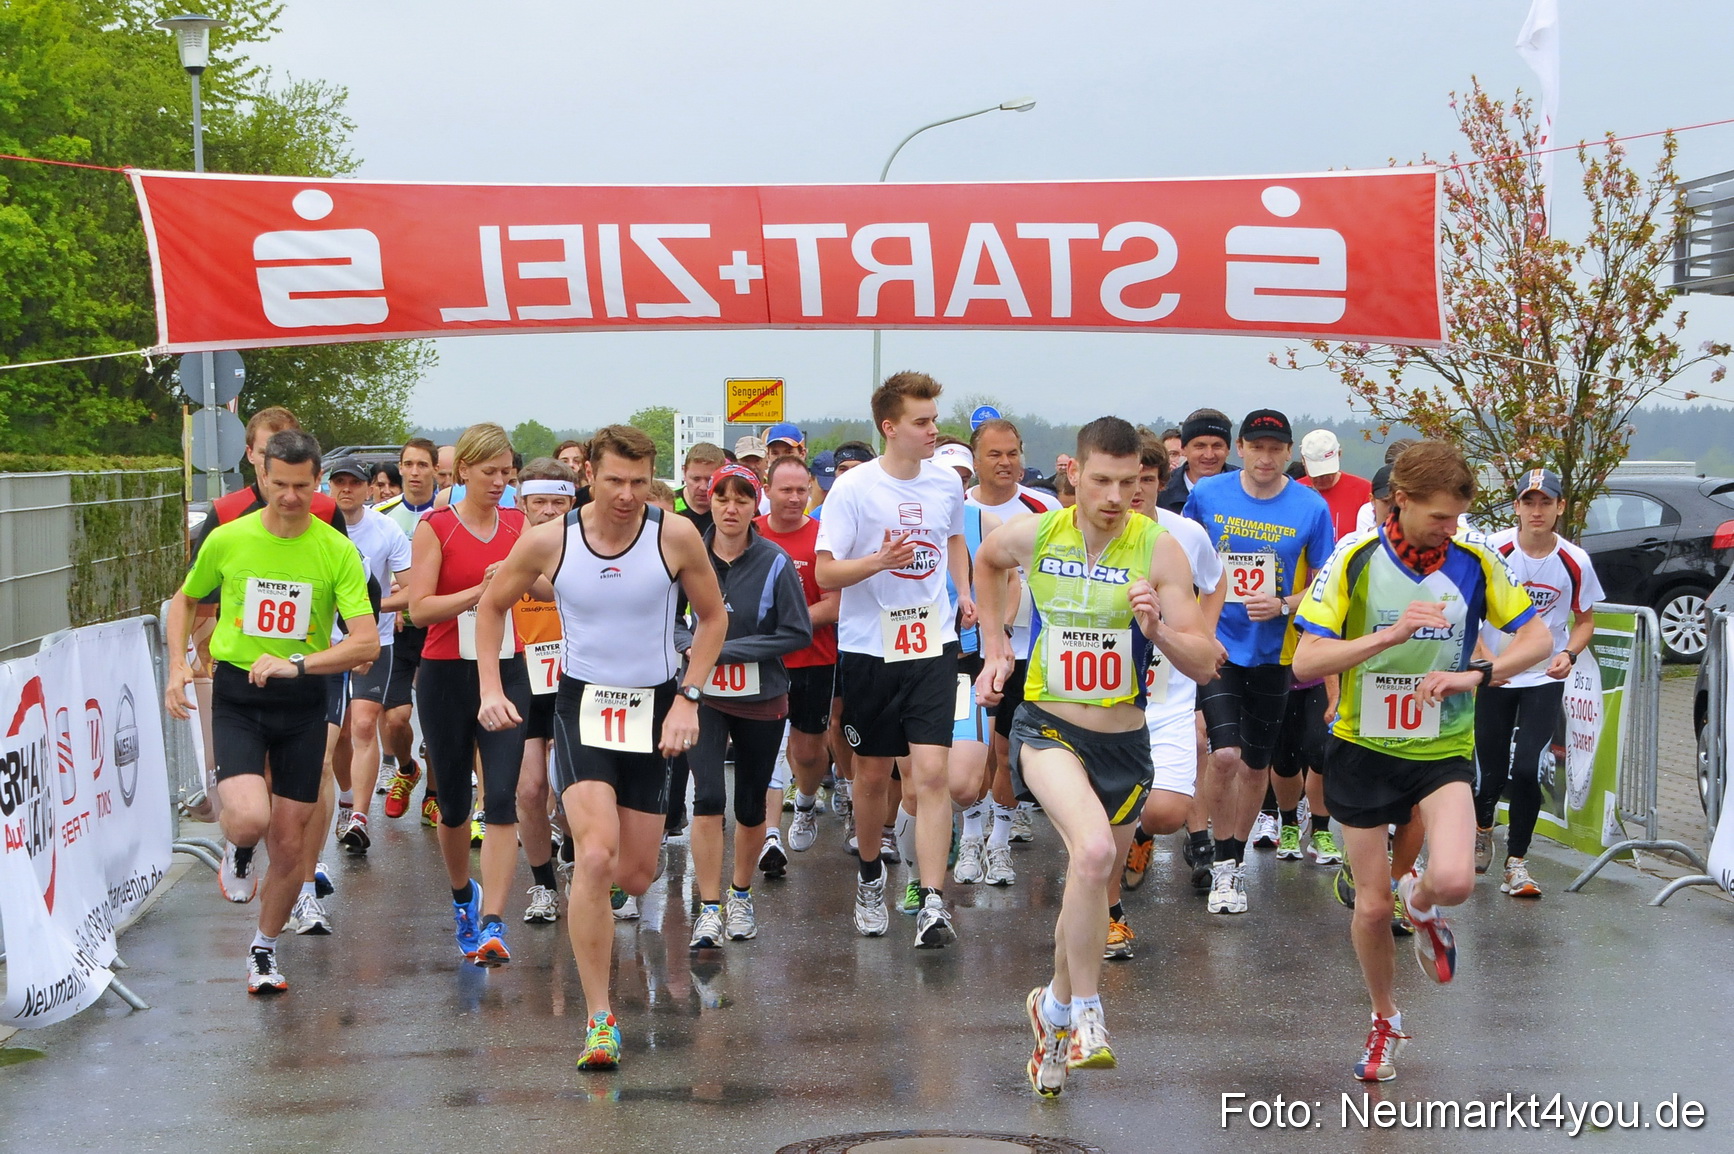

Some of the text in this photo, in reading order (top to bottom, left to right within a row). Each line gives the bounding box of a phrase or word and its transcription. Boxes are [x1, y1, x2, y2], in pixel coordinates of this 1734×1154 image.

[732, 385, 778, 399] Sengenthal
[1213, 514, 1297, 538] 10. NEUMARKTER
[1223, 525, 1282, 544] STADTLAUF
[1228, 554, 1254, 562] MEYER
[1038, 556, 1130, 585] BOCK
[257, 580, 288, 591] MEYER
[1233, 568, 1265, 597] 32
[257, 588, 288, 597] WERBUNG
[257, 599, 297, 634] 68
[890, 608, 917, 617] MEYER
[895, 622, 928, 655] 43
[1062, 631, 1099, 641] MEYER
[535, 643, 560, 652] MEYER
[1062, 640, 1100, 649] WERBUNG
[712, 663, 746, 692] 40
[1060, 650, 1122, 692] 100
[1376, 676, 1412, 685] MEYER
[594, 697, 628, 706] WERBUNG
[595, 690, 628, 700] MEYER
[1384, 693, 1422, 730] 10
[601, 707, 627, 743] 11
